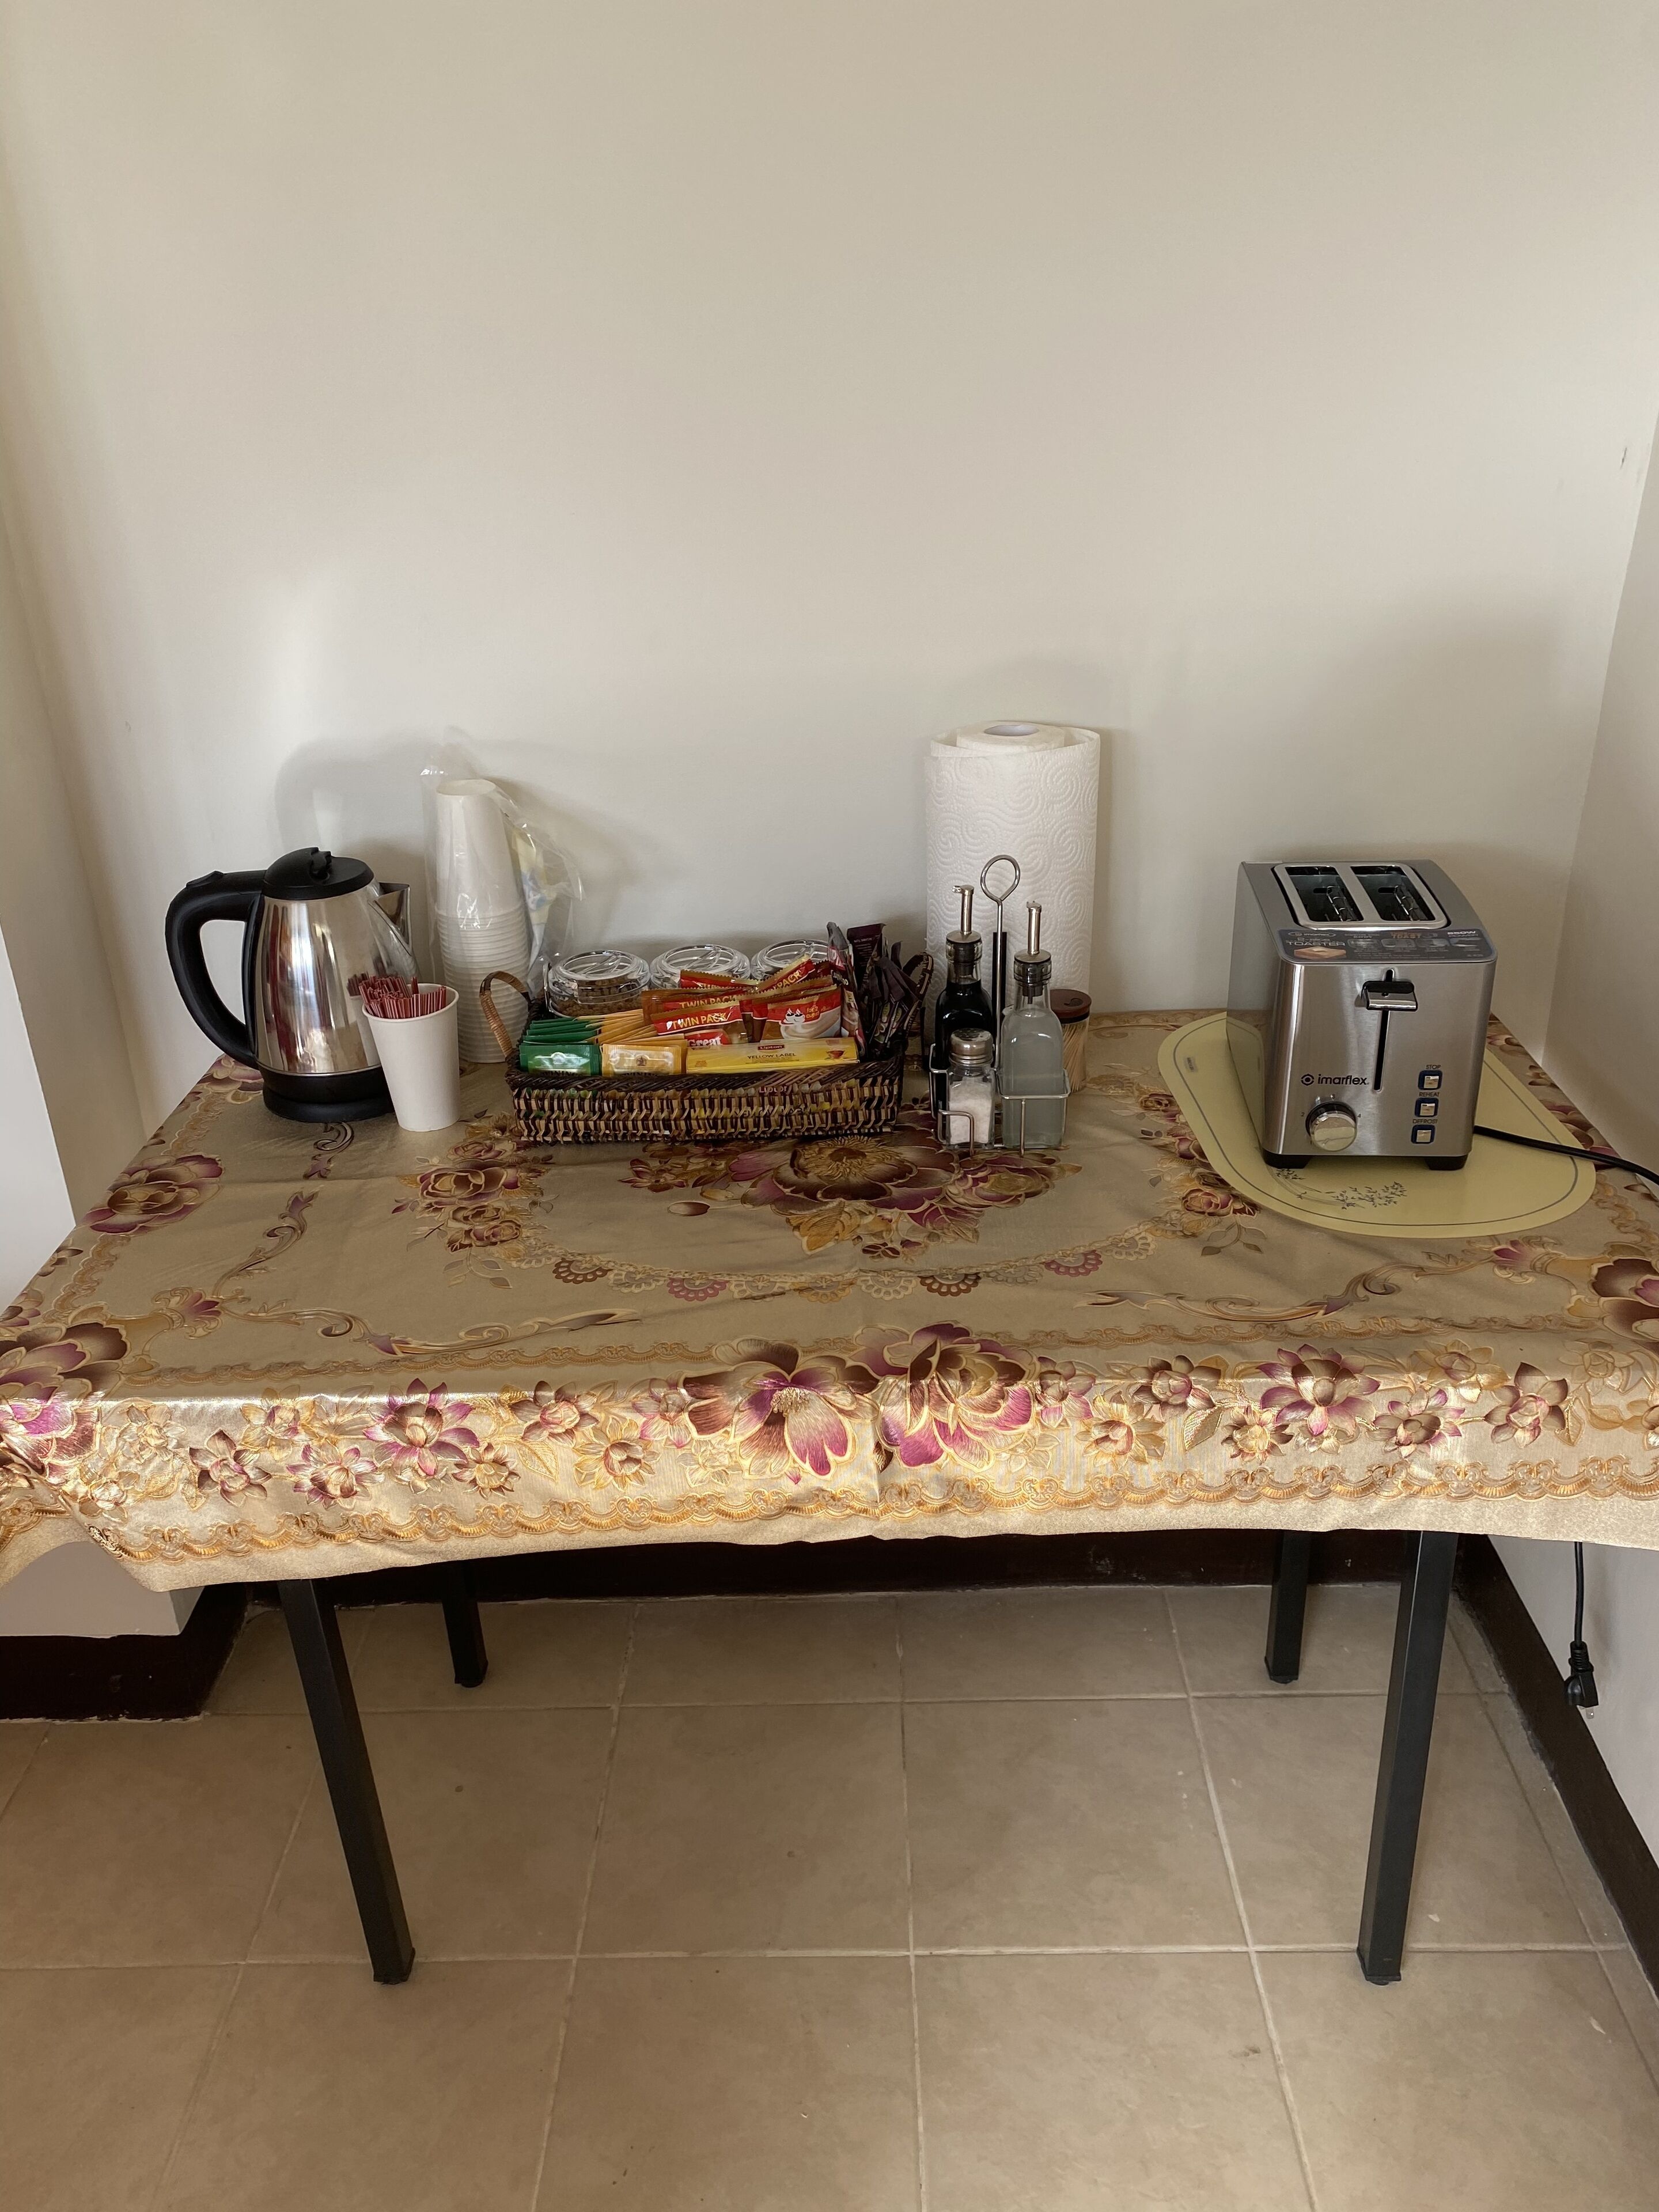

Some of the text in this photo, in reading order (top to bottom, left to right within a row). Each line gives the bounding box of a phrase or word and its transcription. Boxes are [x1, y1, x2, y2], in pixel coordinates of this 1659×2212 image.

[777, 969, 802, 988] PACK
[679, 999, 708, 1009] TWIN
[672, 1012, 727, 1030] TWIN PACK
[688, 1036, 722, 1047] Great
[1317, 1074, 1368, 1085] imarflex
